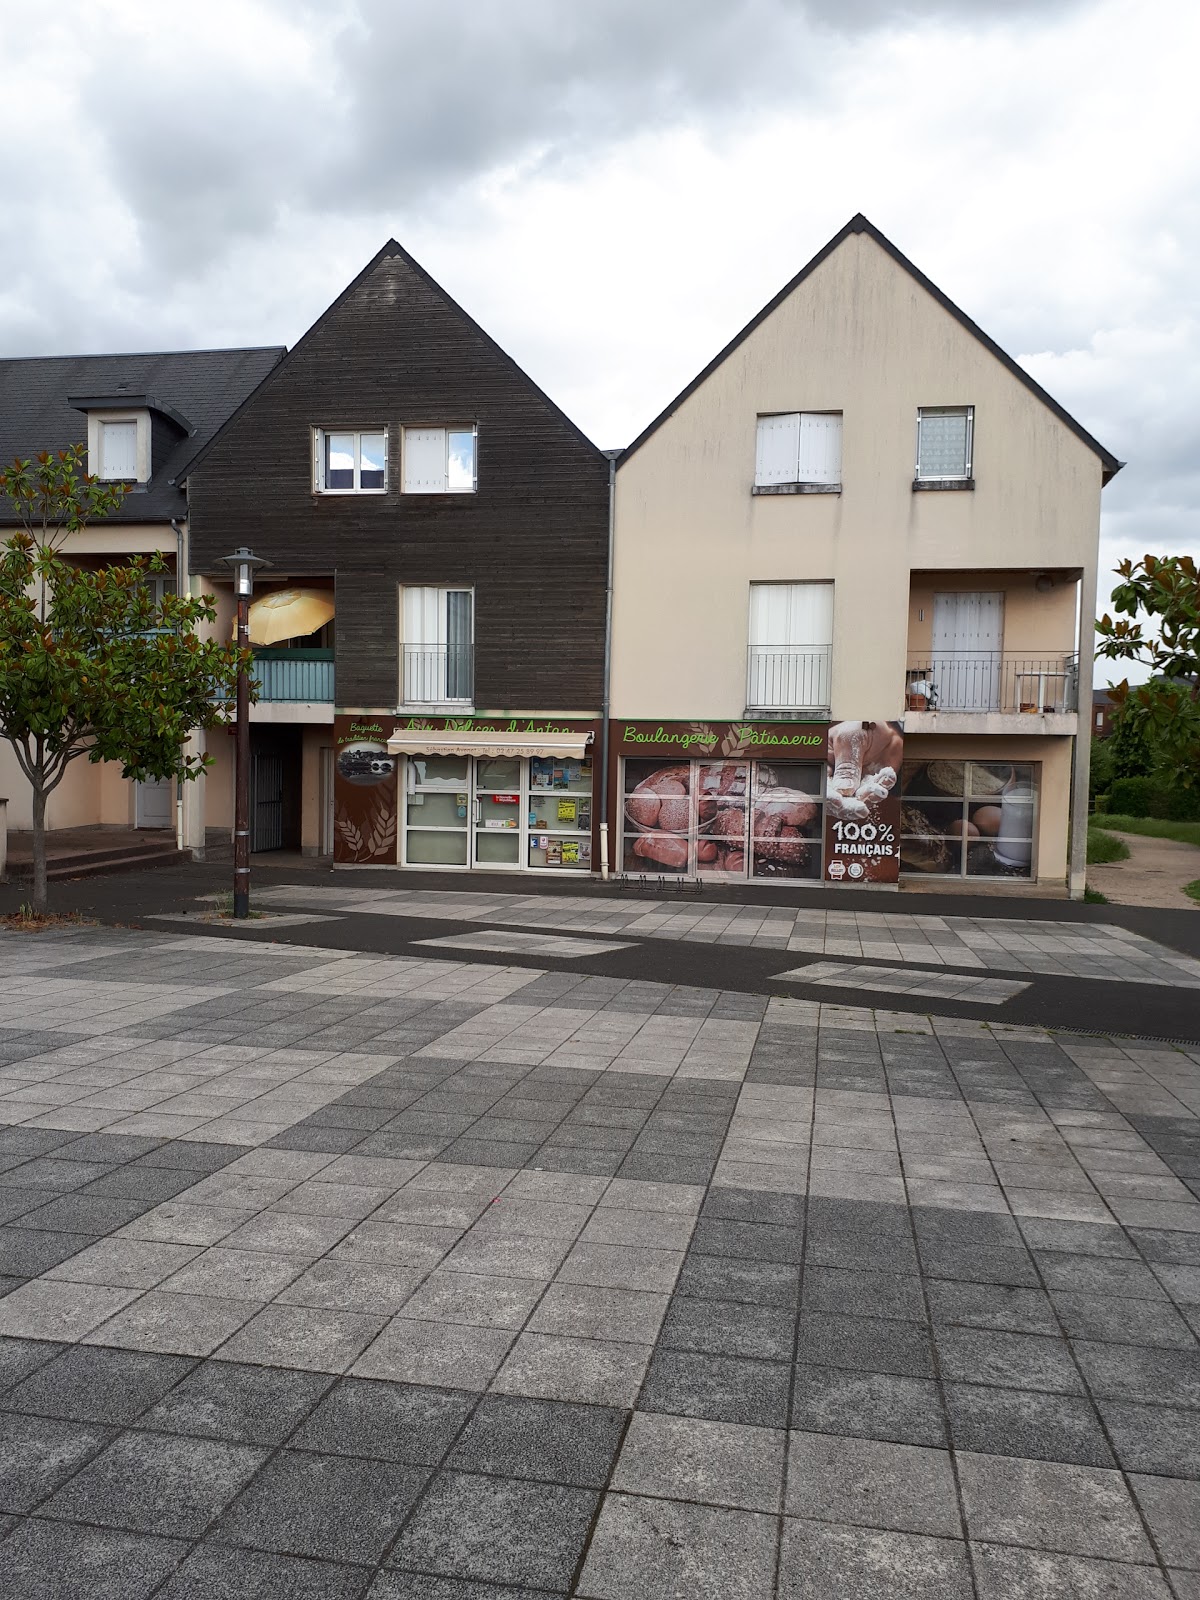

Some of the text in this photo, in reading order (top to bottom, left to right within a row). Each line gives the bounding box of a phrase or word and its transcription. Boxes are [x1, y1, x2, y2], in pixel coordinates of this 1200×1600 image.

[350, 722, 383, 733] Baguette
[345, 734, 368, 743] tradition
[623, 726, 719, 748] Boulangerie
[736, 728, 823, 746] Pâtisserie
[832, 821, 895, 842] 100%
[834, 843, 893, 857] FRANÇAIS
